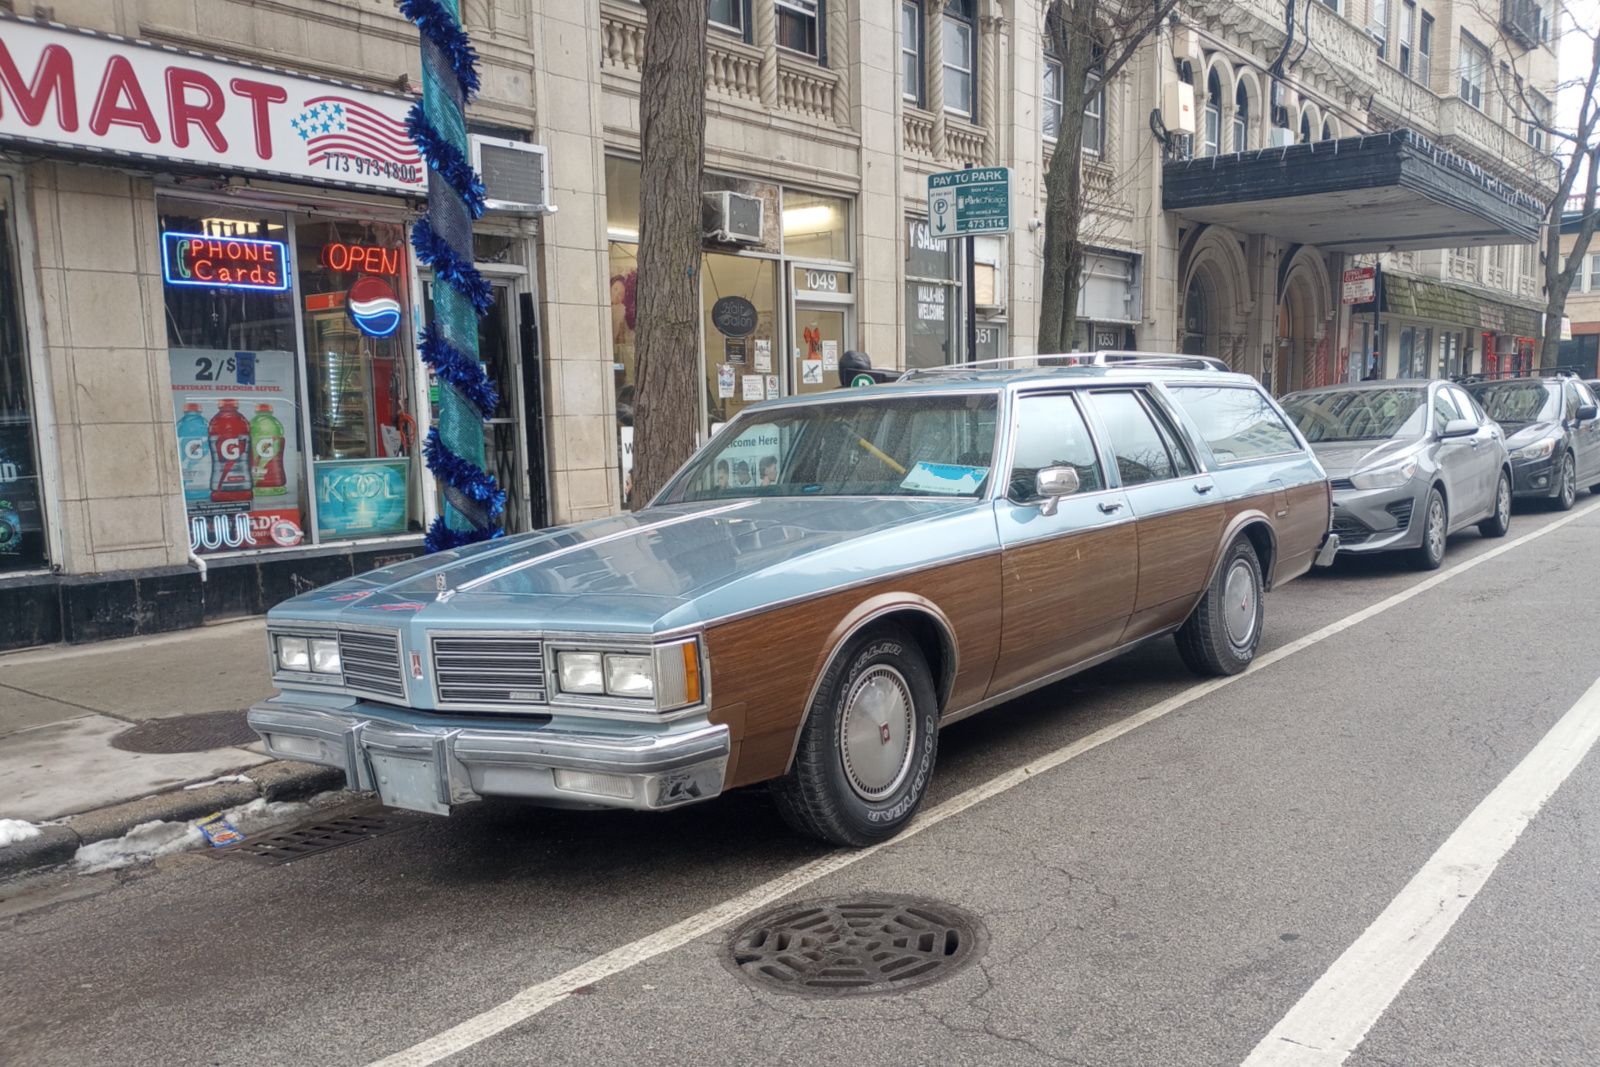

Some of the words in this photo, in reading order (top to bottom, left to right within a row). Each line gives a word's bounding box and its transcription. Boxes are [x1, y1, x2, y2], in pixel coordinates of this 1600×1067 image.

[0, 38, 288, 160] MART
[324, 152, 350, 173] 773
[355, 156, 380, 177] 973
[383, 161, 416, 182] 4800
[933, 175, 952, 186] PAY
[955, 173, 969, 183] TO
[972, 170, 1002, 181] PARK
[191, 239, 275, 262] PHONE
[328, 243, 398, 275] OPEN
[194, 259, 277, 285] Cards
[804, 270, 838, 291] 1049
[918, 285, 944, 303] WALK-INS
[918, 303, 944, 320] WELCOME
[975, 329, 991, 343] 051
[1098, 333, 1114, 346] 1053
[221, 438, 240, 460] G
[758, 435, 778, 446] Here
[322, 472, 400, 504] KOOL
[191, 513, 257, 551] JUUL
[867, 714, 934, 823] GOODYEAR
